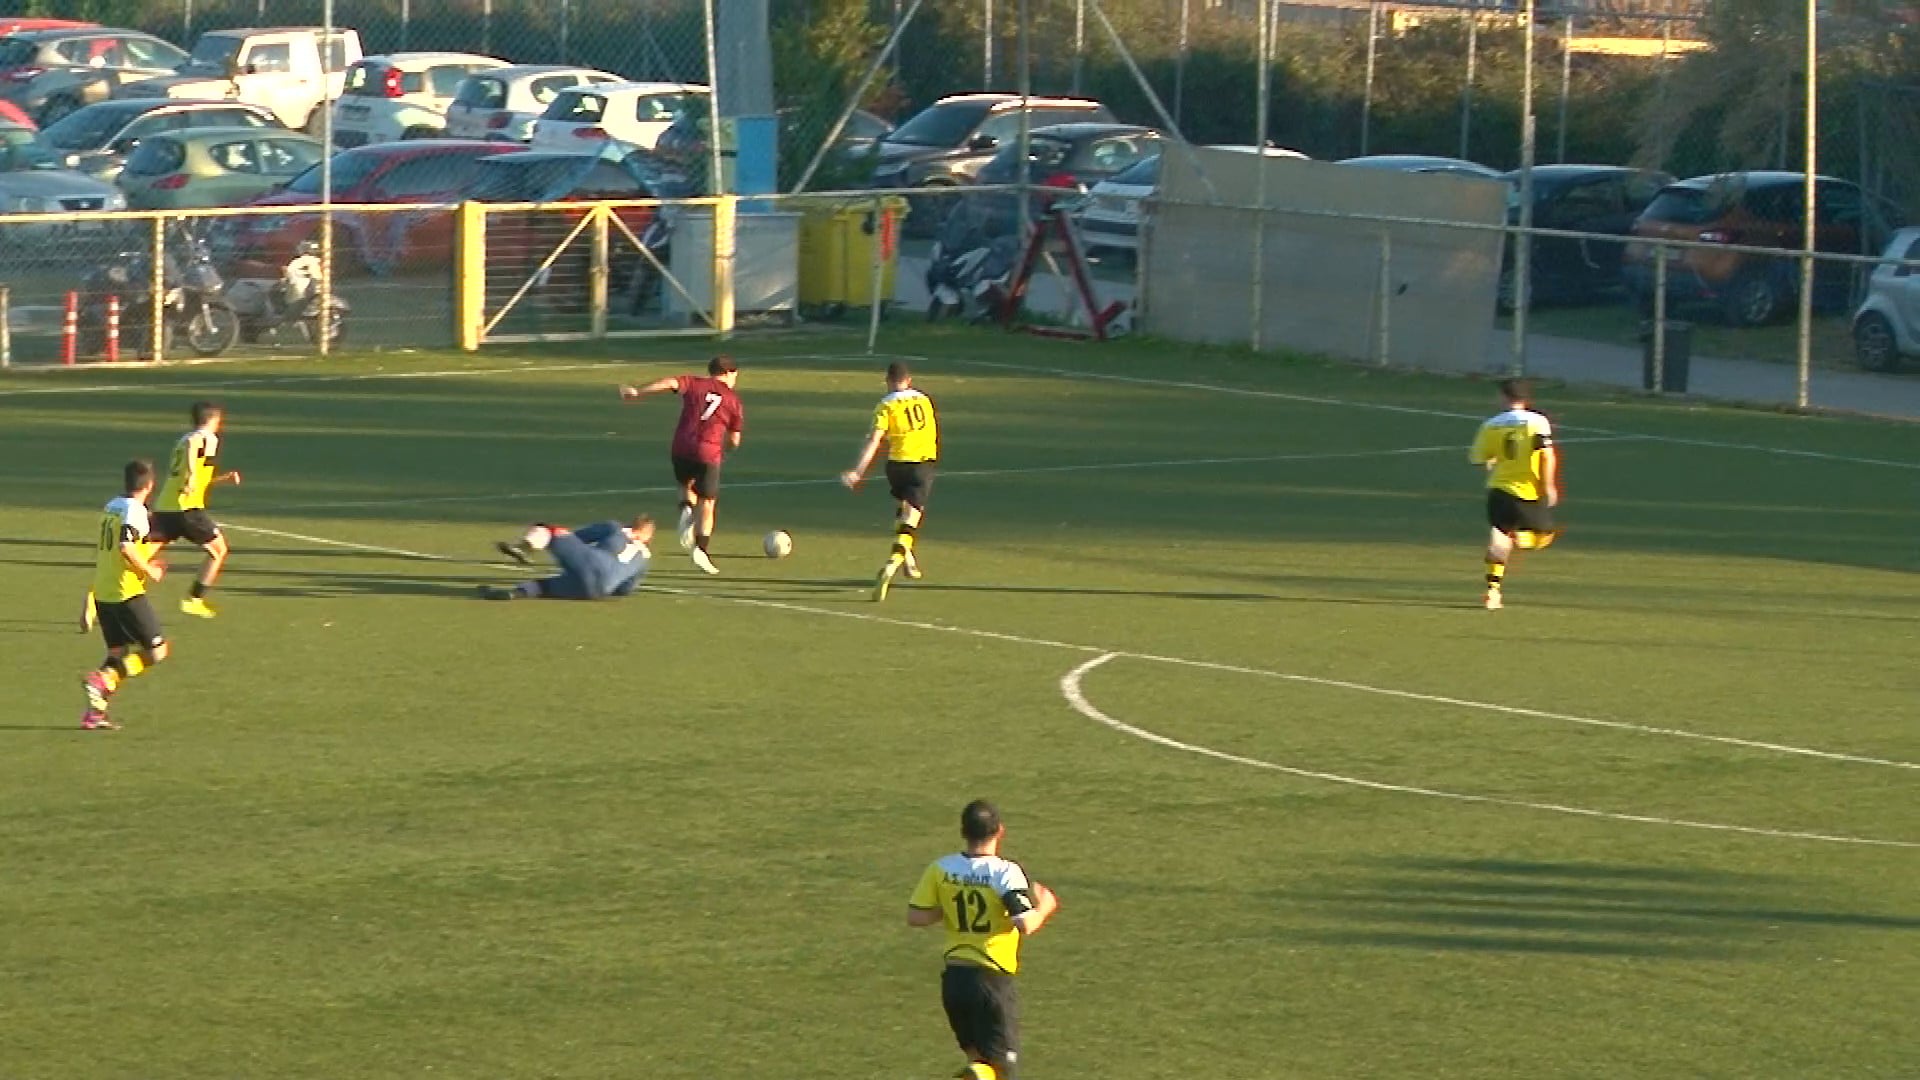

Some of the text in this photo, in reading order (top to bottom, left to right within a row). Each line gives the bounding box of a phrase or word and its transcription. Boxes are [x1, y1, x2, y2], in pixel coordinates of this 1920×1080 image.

[700, 392, 723, 421] 7
[904, 404, 926, 431] 19
[952, 889, 992, 933] 12
